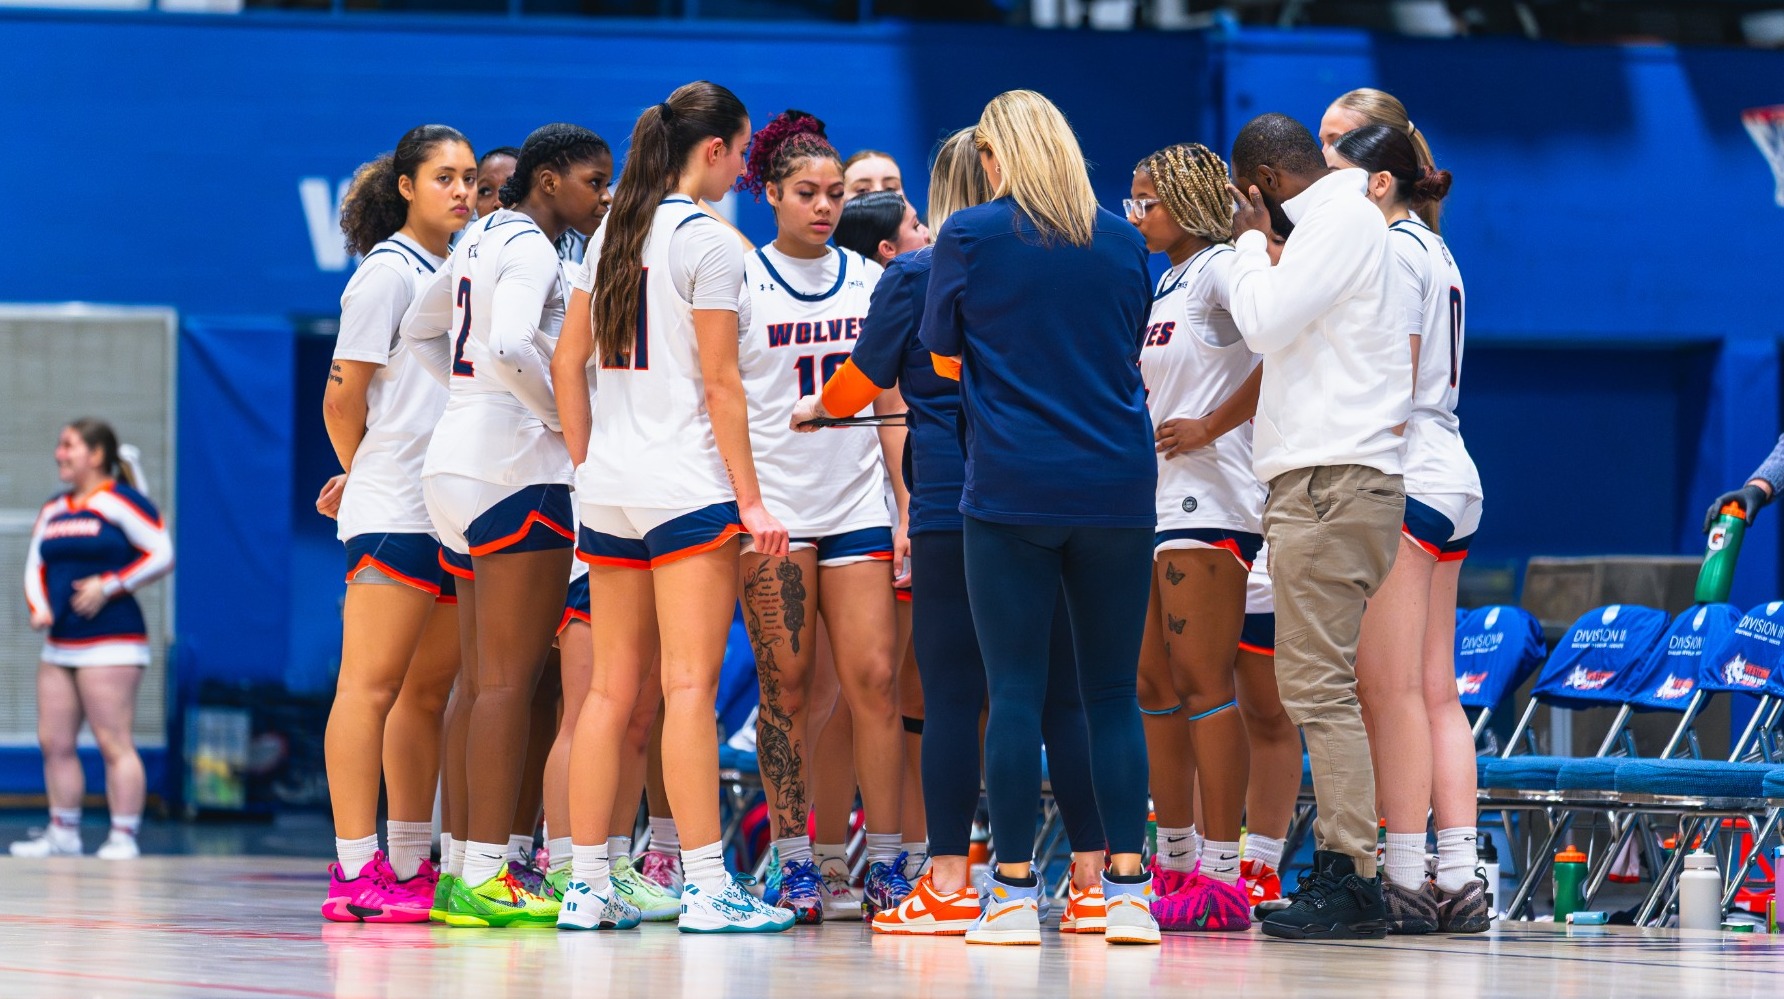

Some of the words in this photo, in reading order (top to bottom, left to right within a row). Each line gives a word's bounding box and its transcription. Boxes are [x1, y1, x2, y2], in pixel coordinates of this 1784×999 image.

[452, 276, 475, 377] 2
[602, 267, 649, 370] 1
[1450, 285, 1461, 388] 0
[1708, 527, 1726, 551] G
[1573, 629, 1618, 643] DIVISION
[1739, 614, 1779, 637] DIVISION
[1088, 886, 1104, 895] NIKE
